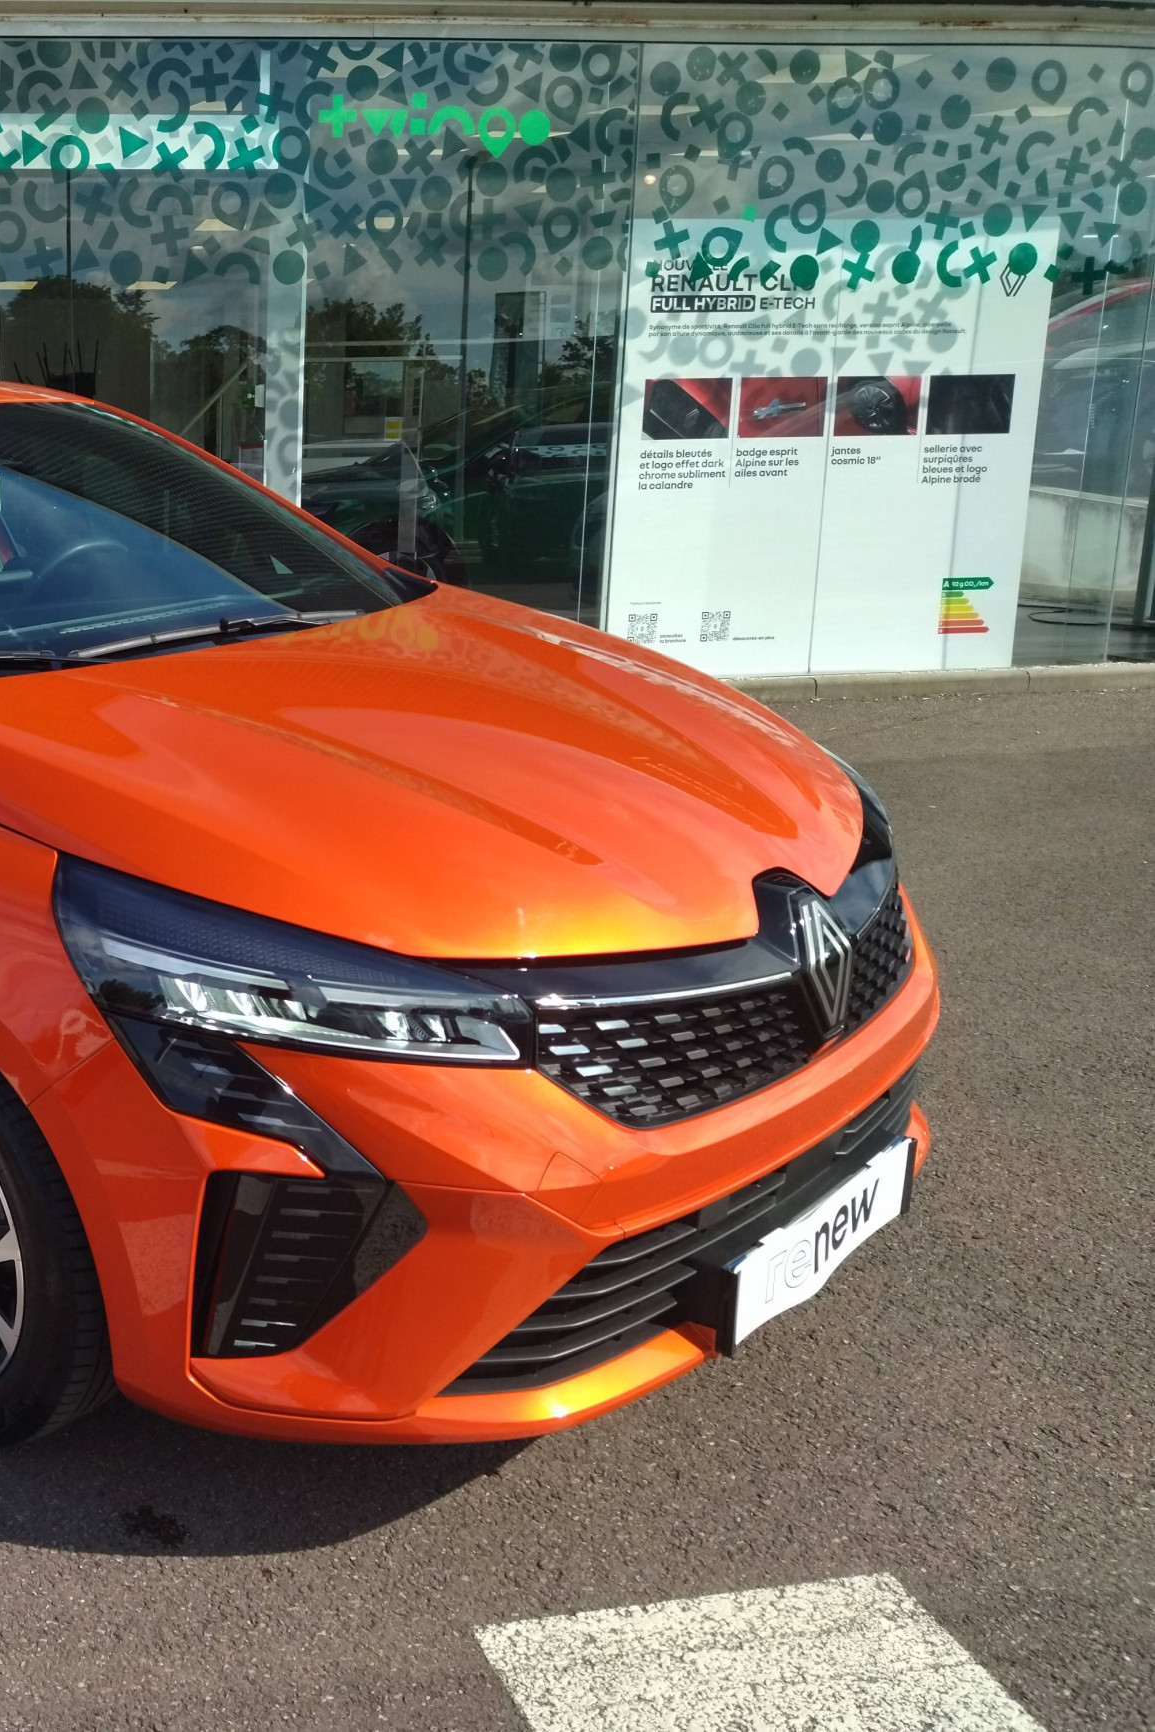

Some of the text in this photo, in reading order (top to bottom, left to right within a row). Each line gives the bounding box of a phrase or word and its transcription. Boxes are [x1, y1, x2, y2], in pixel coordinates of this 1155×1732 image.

[651, 274, 816, 292] RENAULT CL
[652, 297, 816, 311] FULL HYBRID E-TECH
[640, 449, 712, 459] détails bleutés
[736, 447, 798, 459] badge esprit
[831, 446, 861, 457] jantes
[924, 444, 983, 454] sellerie avec
[640, 459, 724, 471] et logo effet dark
[735, 458, 800, 469] Alpine sur les
[831, 456, 865, 465] cosmic
[923, 454, 973, 465] surpiqûres
[639, 470, 726, 480] chrome subliment
[734, 468, 788, 478] ailes avant
[922, 464, 988, 475] bleues et logo
[638, 480, 693, 490] la calandre
[922, 474, 981, 486] Alpine brodé
[765, 1178, 880, 1304] renew
